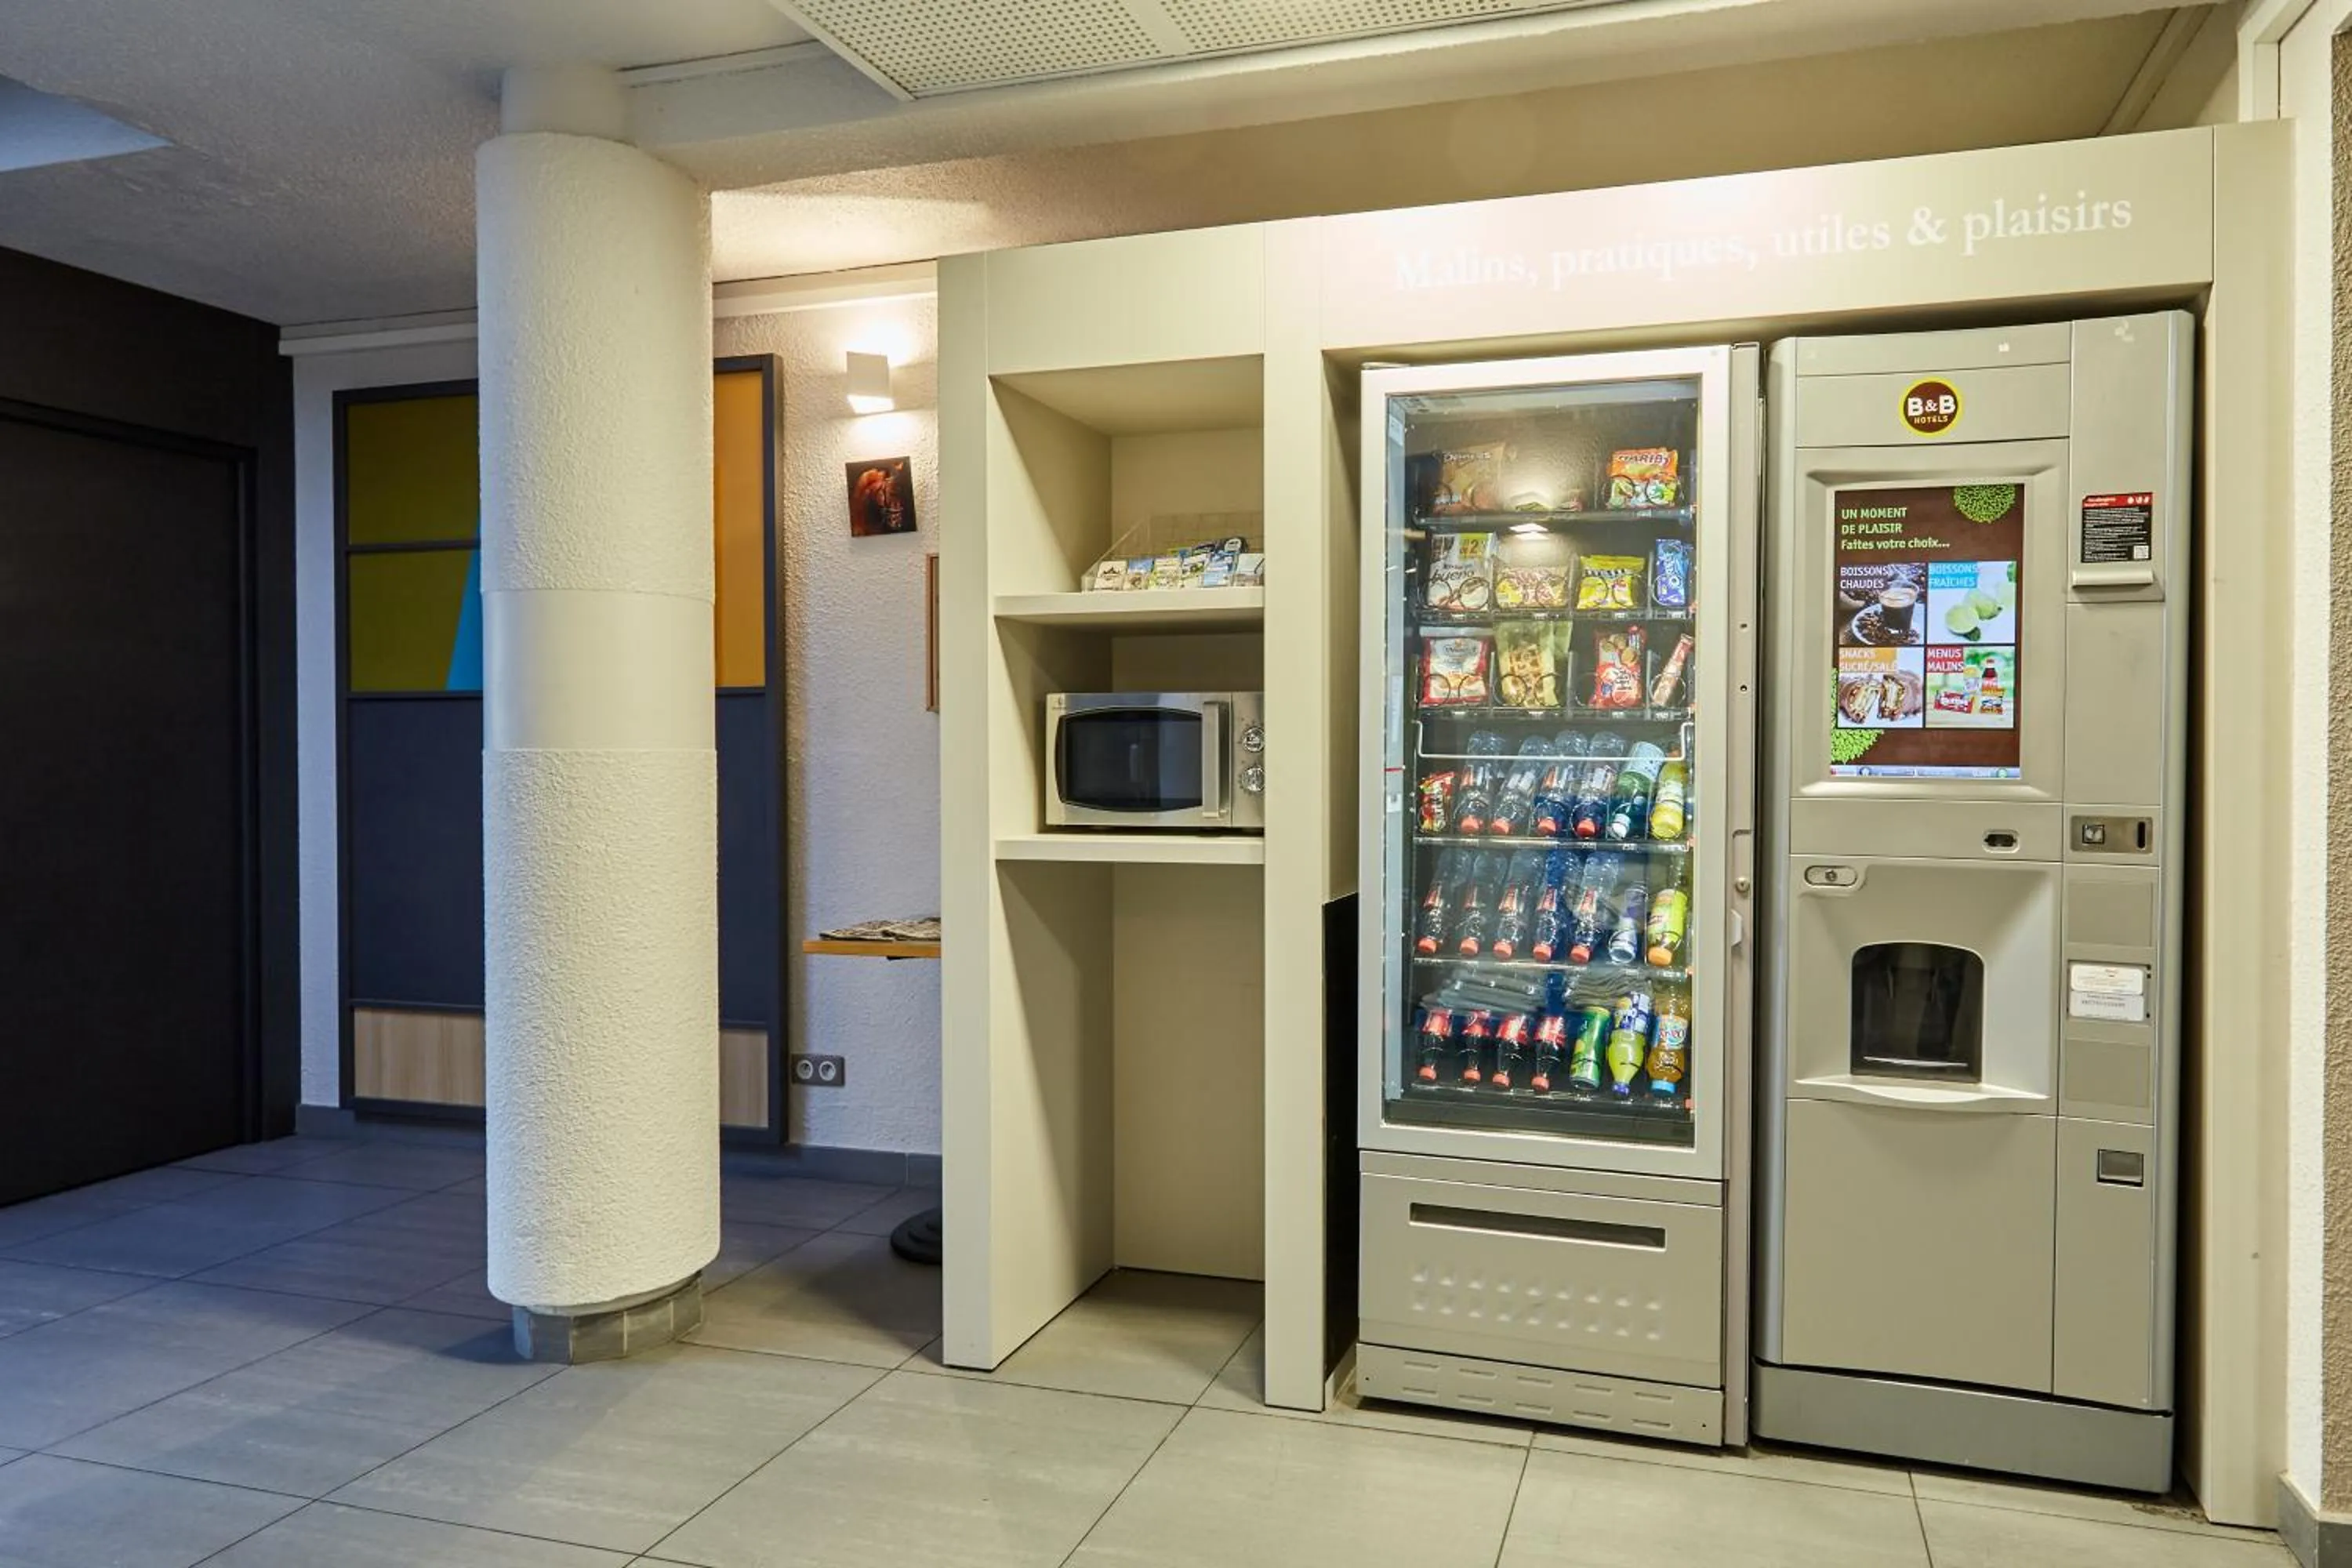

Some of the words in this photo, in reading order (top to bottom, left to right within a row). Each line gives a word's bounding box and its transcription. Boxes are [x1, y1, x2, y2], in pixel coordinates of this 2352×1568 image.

[1395, 245, 1538, 291] Malins,
[1548, 230, 1759, 291] pratiques,
[1772, 210, 1892, 256] utiles
[1907, 205, 1948, 246] &
[1961, 190, 2133, 257] plaisirs
[1907, 394, 1956, 416] B&B
[1914, 415, 1948, 424] HOTELS
[1842, 508, 1857, 520] UN
[1860, 506, 1907, 519] MOMENT
[1842, 524, 1856, 535] DE
[1858, 523, 1903, 534] PLAISIR
[1842, 539, 1874, 550] Faites
[1876, 539, 1906, 550] votre
[1907, 537, 1951, 549] choix...
[1840, 564, 1889, 577] BOISSONS
[1840, 579, 1885, 589] CHAUDES
[1928, 648, 1962, 659] MENUS
[1927, 661, 1964, 673] MALINS
